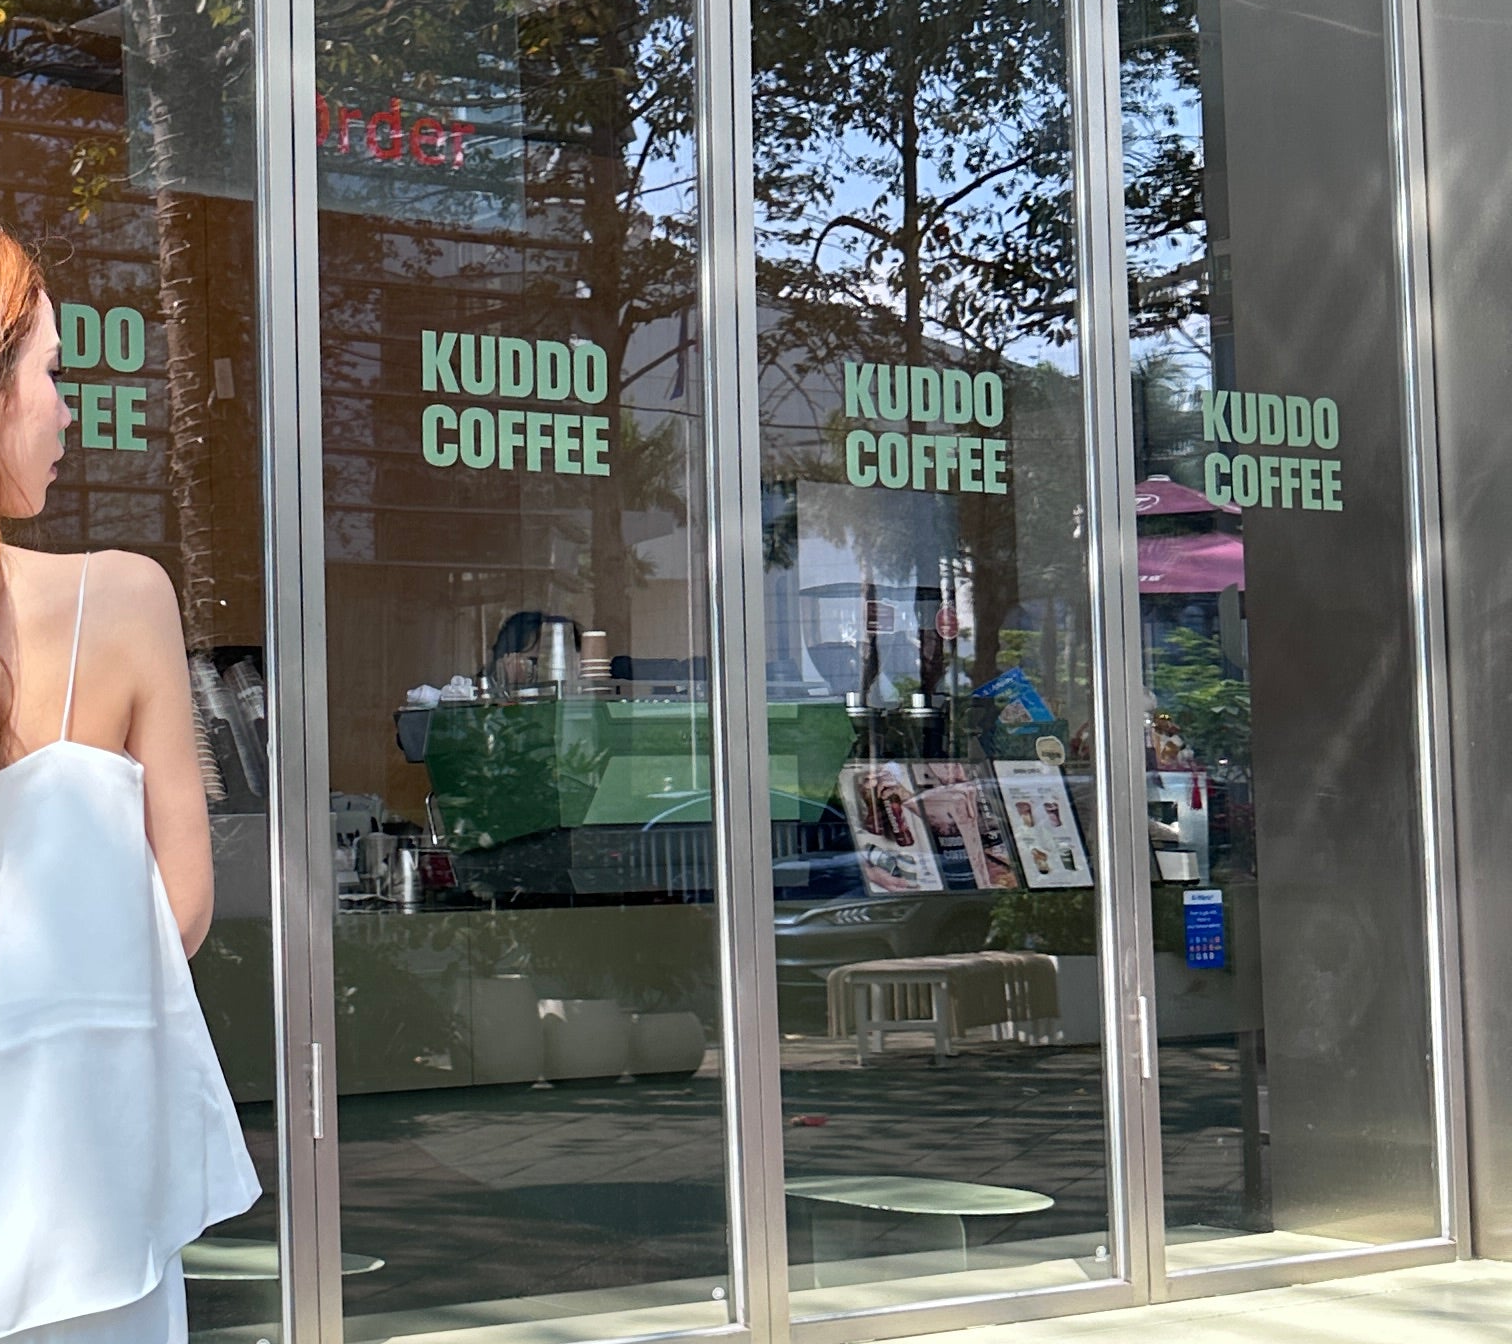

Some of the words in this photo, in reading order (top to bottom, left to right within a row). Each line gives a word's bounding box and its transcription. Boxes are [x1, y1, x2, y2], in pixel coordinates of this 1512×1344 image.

[422, 330, 608, 404] KUDDO
[844, 362, 1003, 427] KUDDO
[422, 404, 610, 476] COFFEE
[1203, 390, 1339, 449] KUDDO
[845, 430, 1007, 495] COFFEE
[1204, 453, 1343, 512] COFFEE
